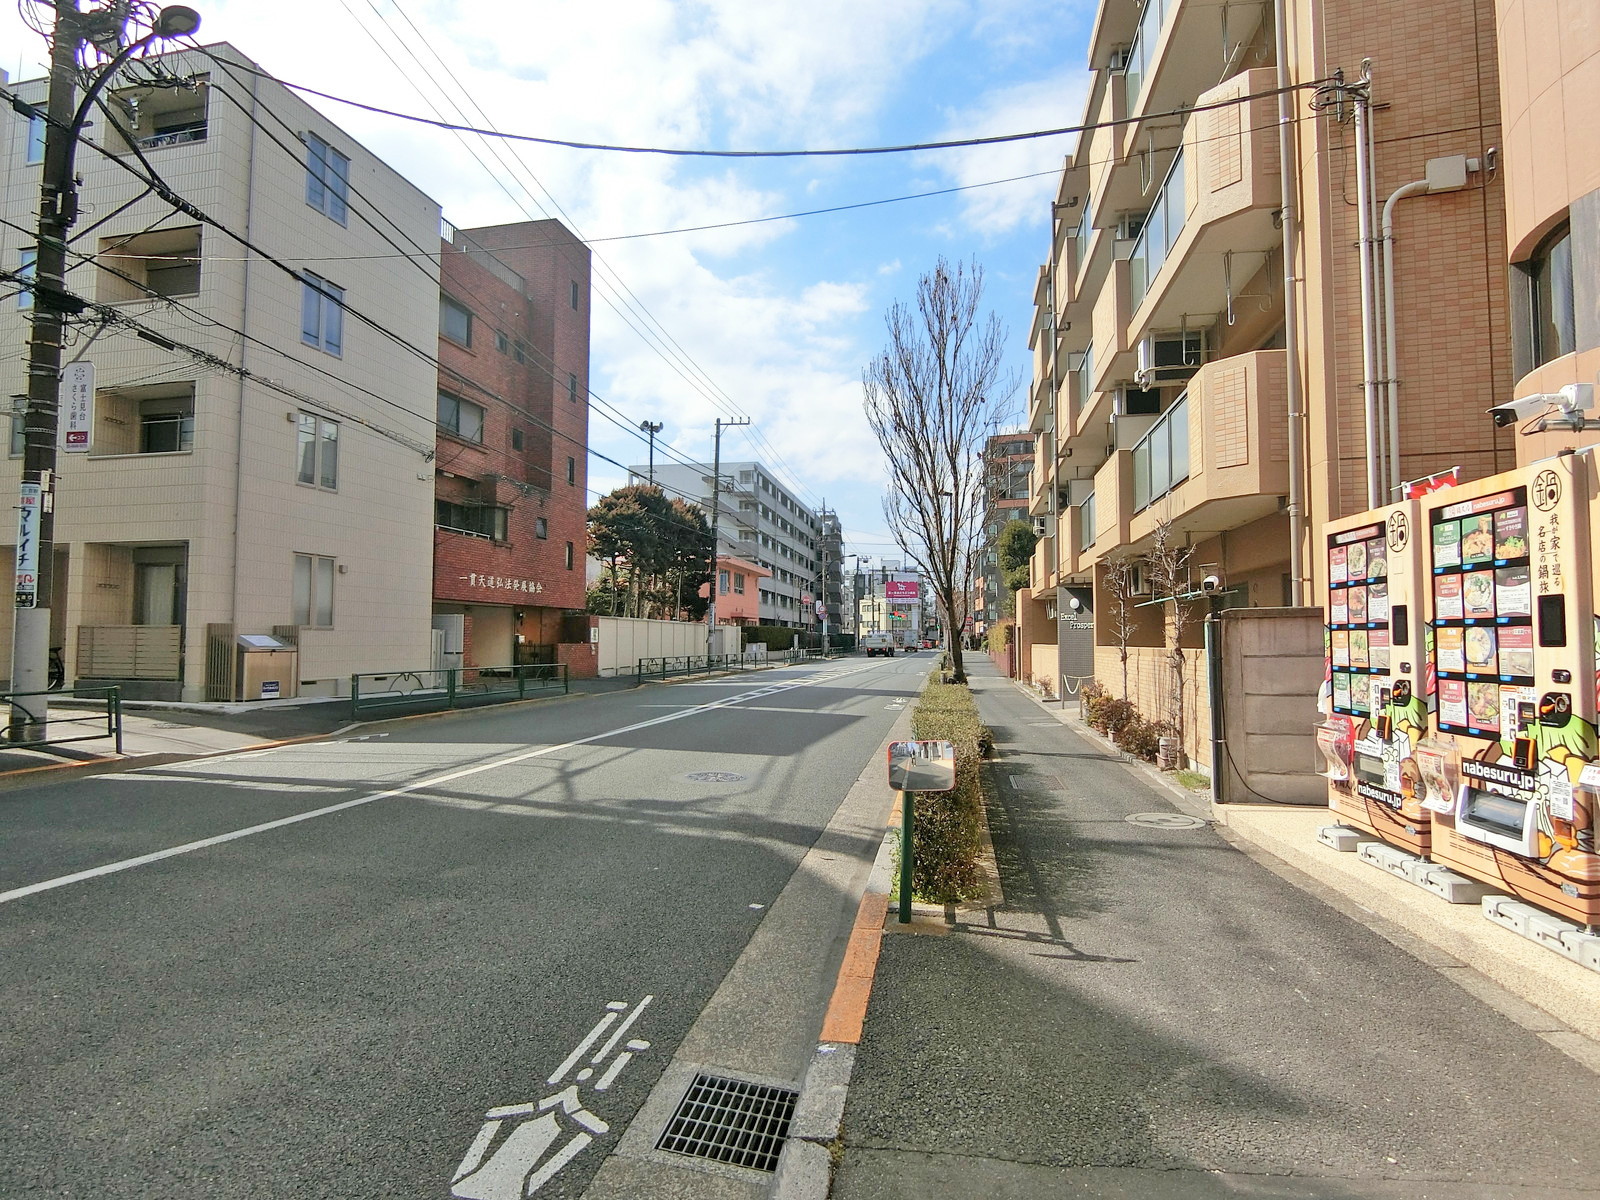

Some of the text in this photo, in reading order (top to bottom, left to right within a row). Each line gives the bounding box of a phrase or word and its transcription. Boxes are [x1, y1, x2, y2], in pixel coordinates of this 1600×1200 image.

[79, 384, 87, 421] 富士見台
[18, 507, 32, 567] マルイチ
[1537, 525, 1550, 594] 名店の鍋旅
[1550, 512, 1562, 587] 我が家で巡る
[1358, 784, 1402, 809] nabesuru.jp
[1462, 762, 1534, 790] nabesuru.jp
